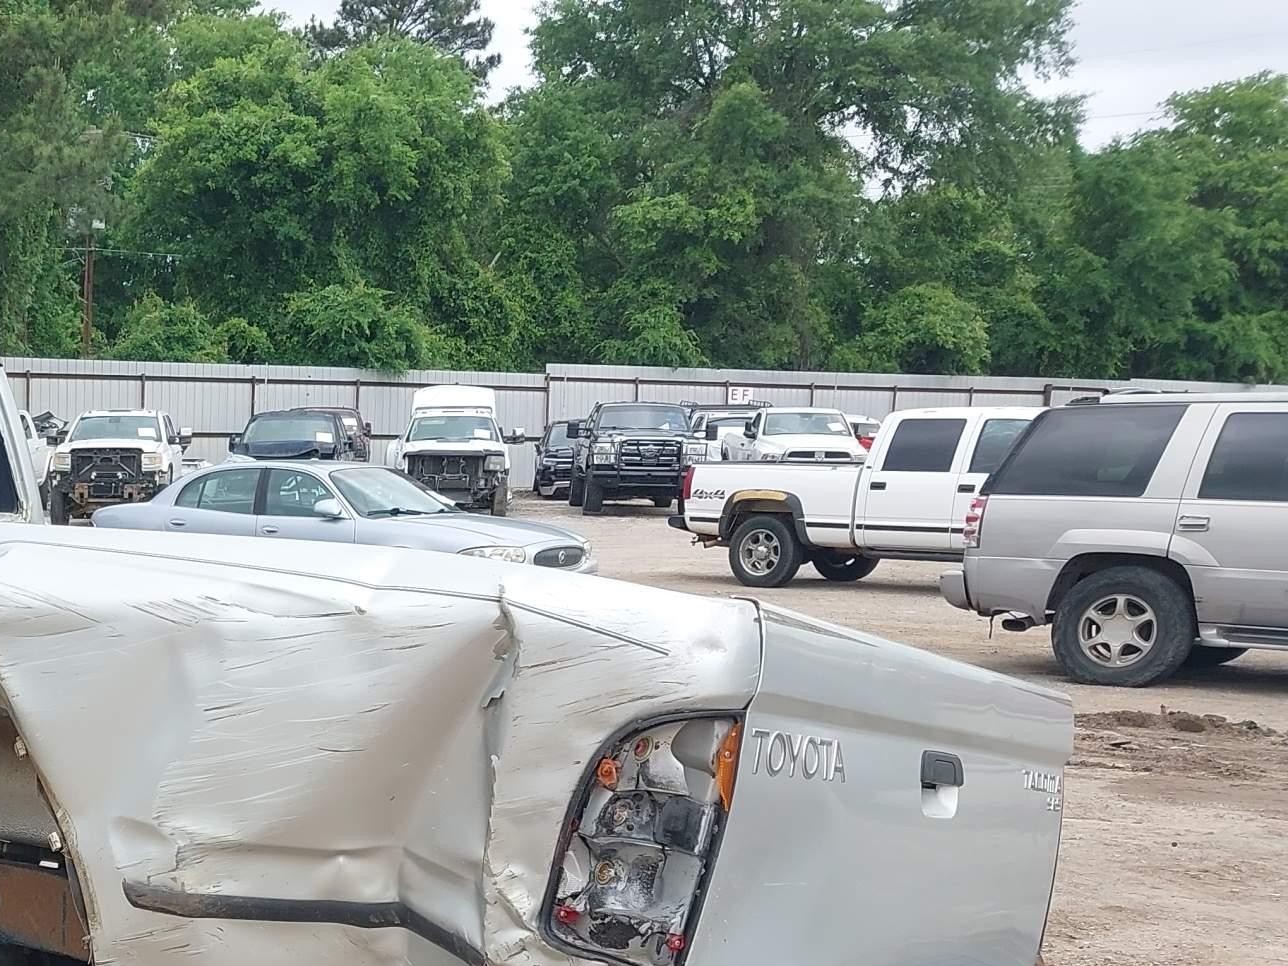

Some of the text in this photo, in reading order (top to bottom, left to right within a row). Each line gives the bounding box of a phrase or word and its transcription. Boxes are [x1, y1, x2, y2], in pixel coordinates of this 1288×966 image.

[731, 388, 750, 401] E F
[752, 728, 846, 783] TOYOTA
